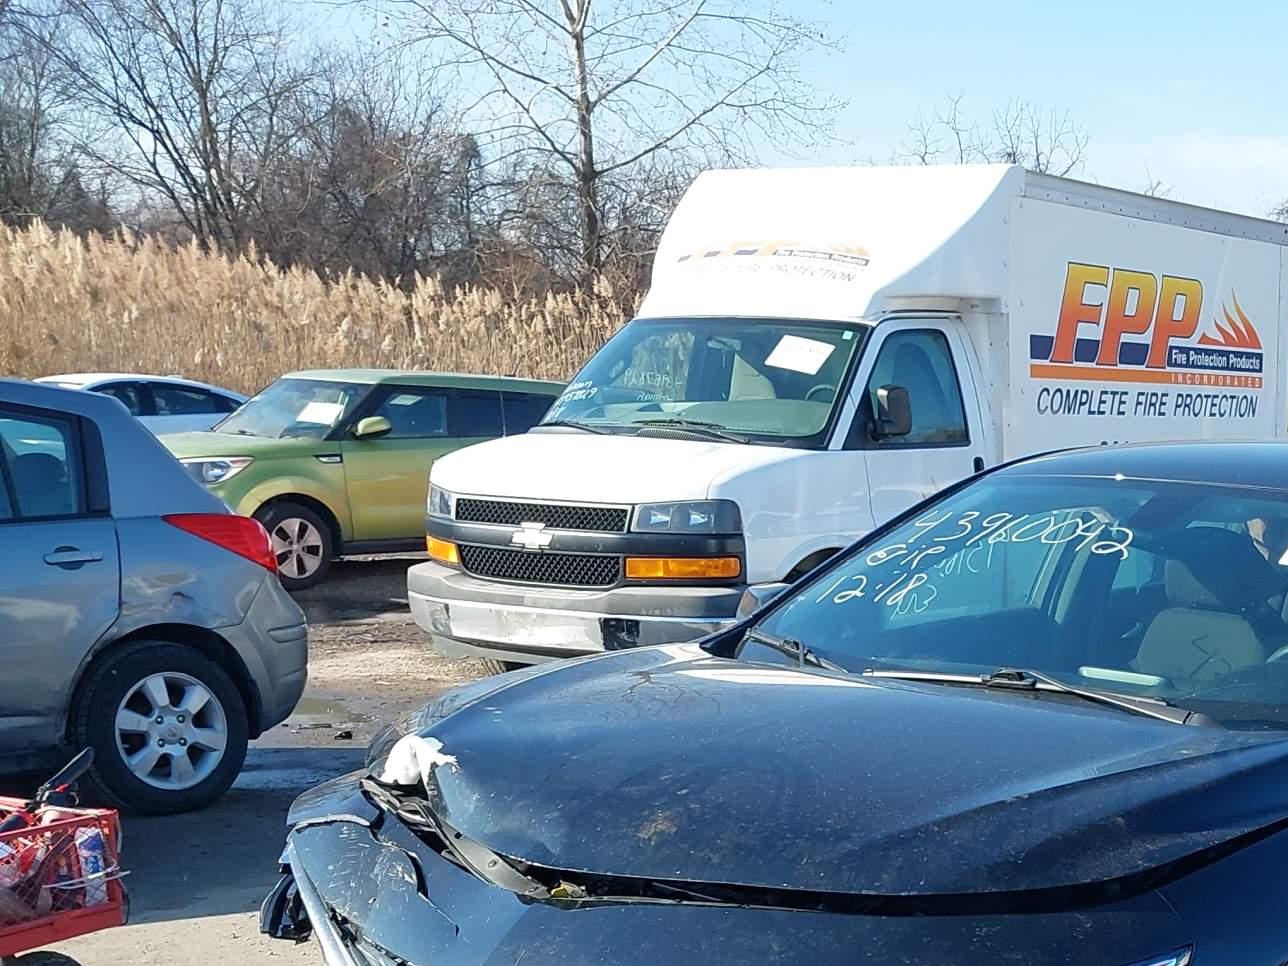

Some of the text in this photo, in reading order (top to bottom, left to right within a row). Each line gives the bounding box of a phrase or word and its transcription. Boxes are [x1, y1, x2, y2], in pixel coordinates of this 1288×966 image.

[1050, 262, 1203, 368] FPP
[1171, 349, 1261, 370] Fire Protection Products
[1171, 373, 1260, 387] INCORPORATED
[1036, 387, 1259, 418] COMPLETE FIRE PROTECTION
